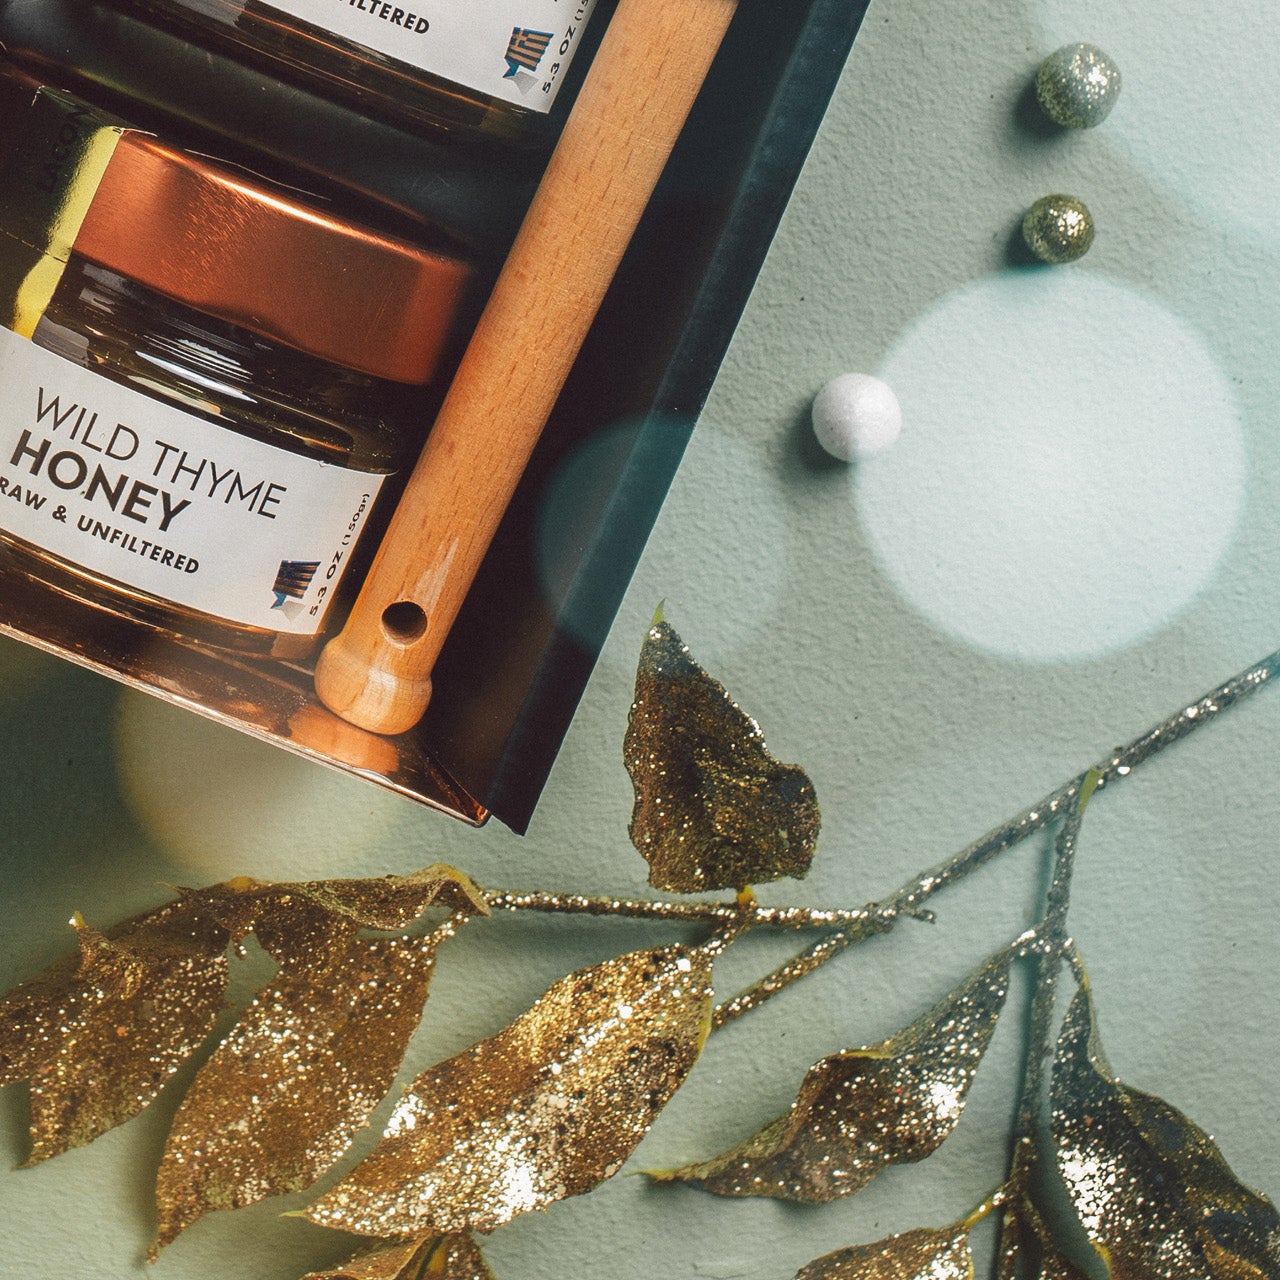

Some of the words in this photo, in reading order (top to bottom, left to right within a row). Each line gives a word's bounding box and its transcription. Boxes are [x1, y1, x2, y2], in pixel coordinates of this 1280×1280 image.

[559, 25, 577, 55] OZ
[10, 430, 191, 532] HONEY
[36, 387, 139, 461] WILD
[154, 439, 287, 519] THYME
[52, 505, 67, 522] &
[77, 515, 200, 575] UNFILTERED
[326, 551, 344, 580] OZ
